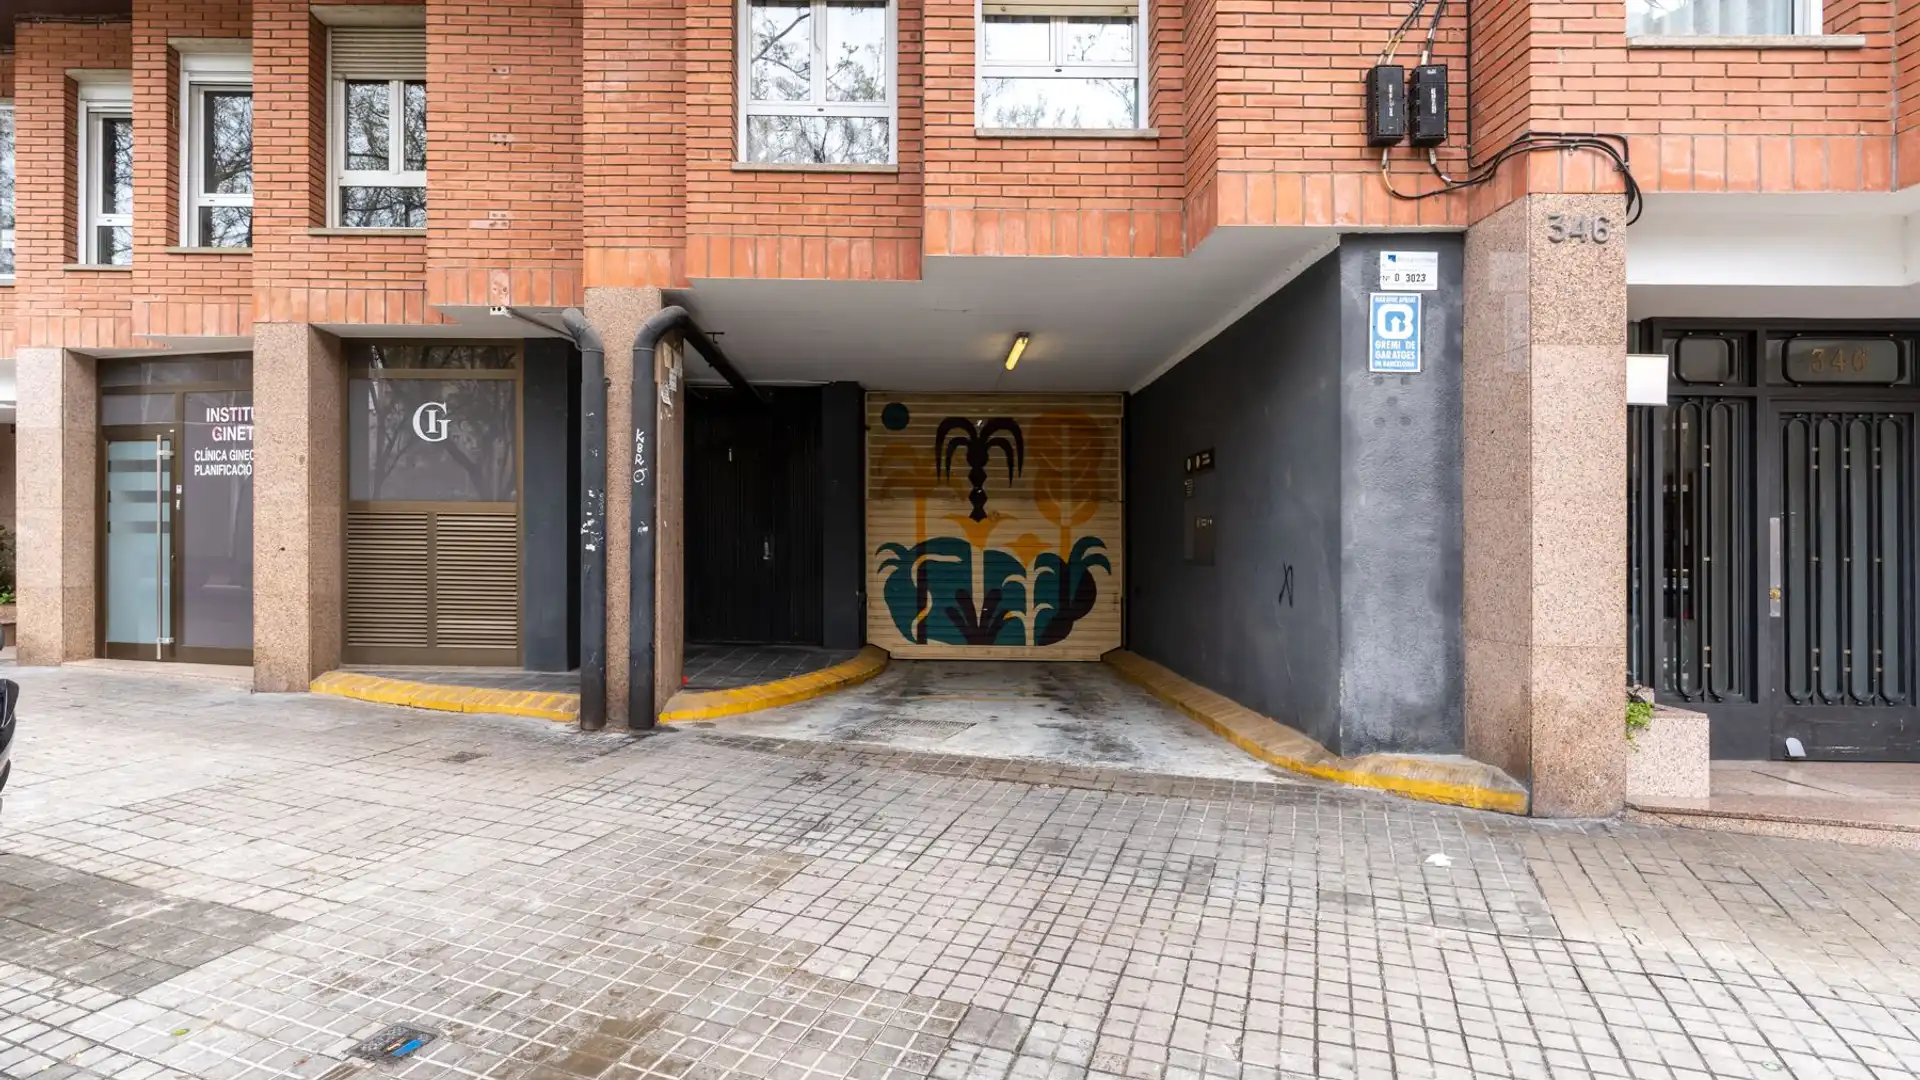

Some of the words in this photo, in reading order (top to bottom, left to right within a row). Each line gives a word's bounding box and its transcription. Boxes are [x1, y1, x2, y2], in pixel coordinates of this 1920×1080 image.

[1546, 212, 1611, 244] 346
[1405, 273, 1427, 283] 3023
[1375, 340, 1400, 350] GREMI
[1405, 341, 1416, 350] DE
[1375, 350, 1416, 360] GARATGES
[1809, 347, 1868, 374] 346
[212, 426, 254, 441] GINET
[194, 447, 228, 461] CLÍNICA
